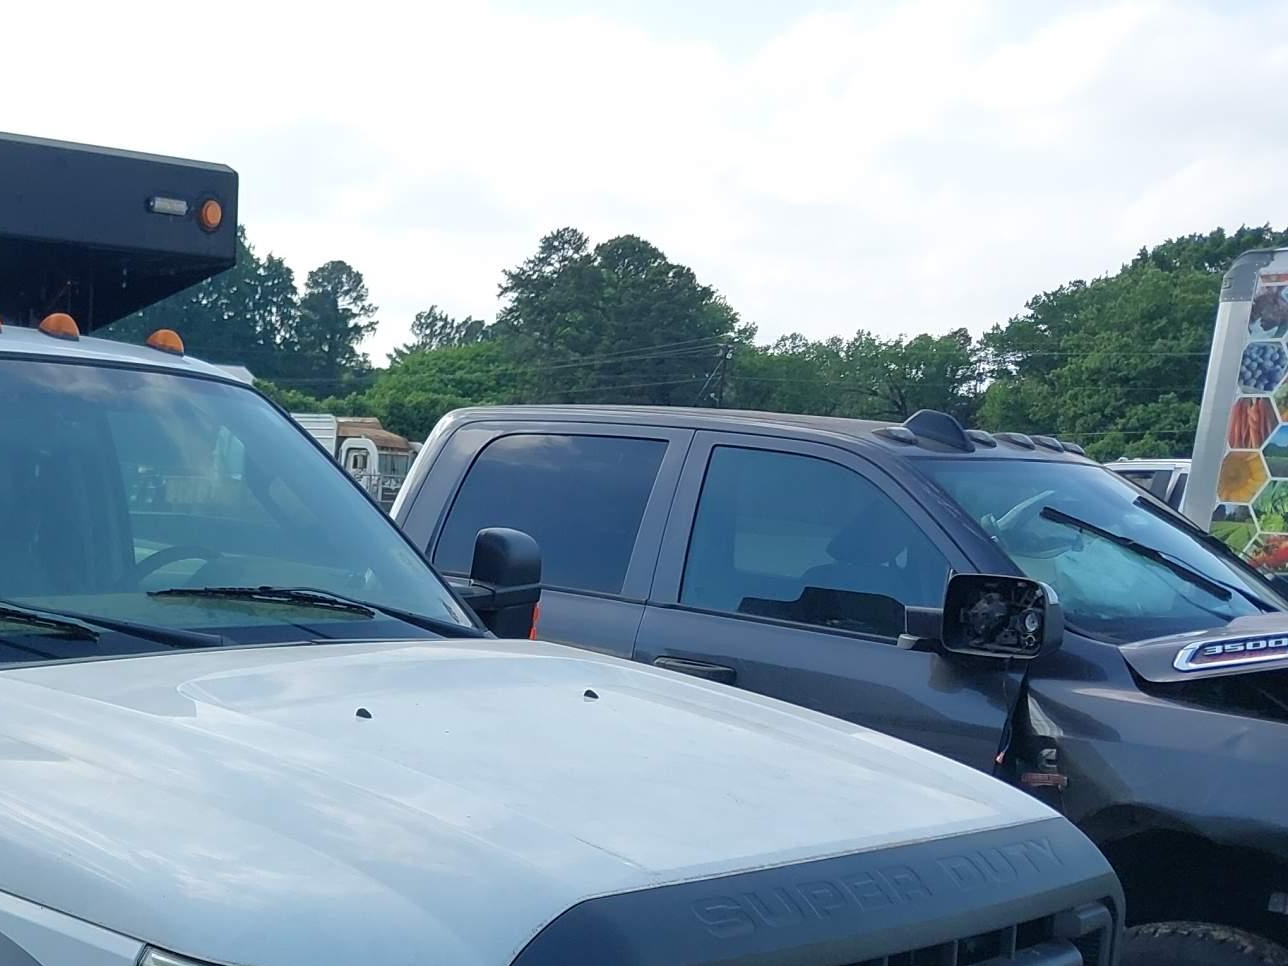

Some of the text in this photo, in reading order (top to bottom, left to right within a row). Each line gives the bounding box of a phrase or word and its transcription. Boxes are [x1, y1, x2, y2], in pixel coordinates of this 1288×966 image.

[1203, 637, 1288, 656] 3500
[690, 836, 1065, 939] SUPER DUTY
